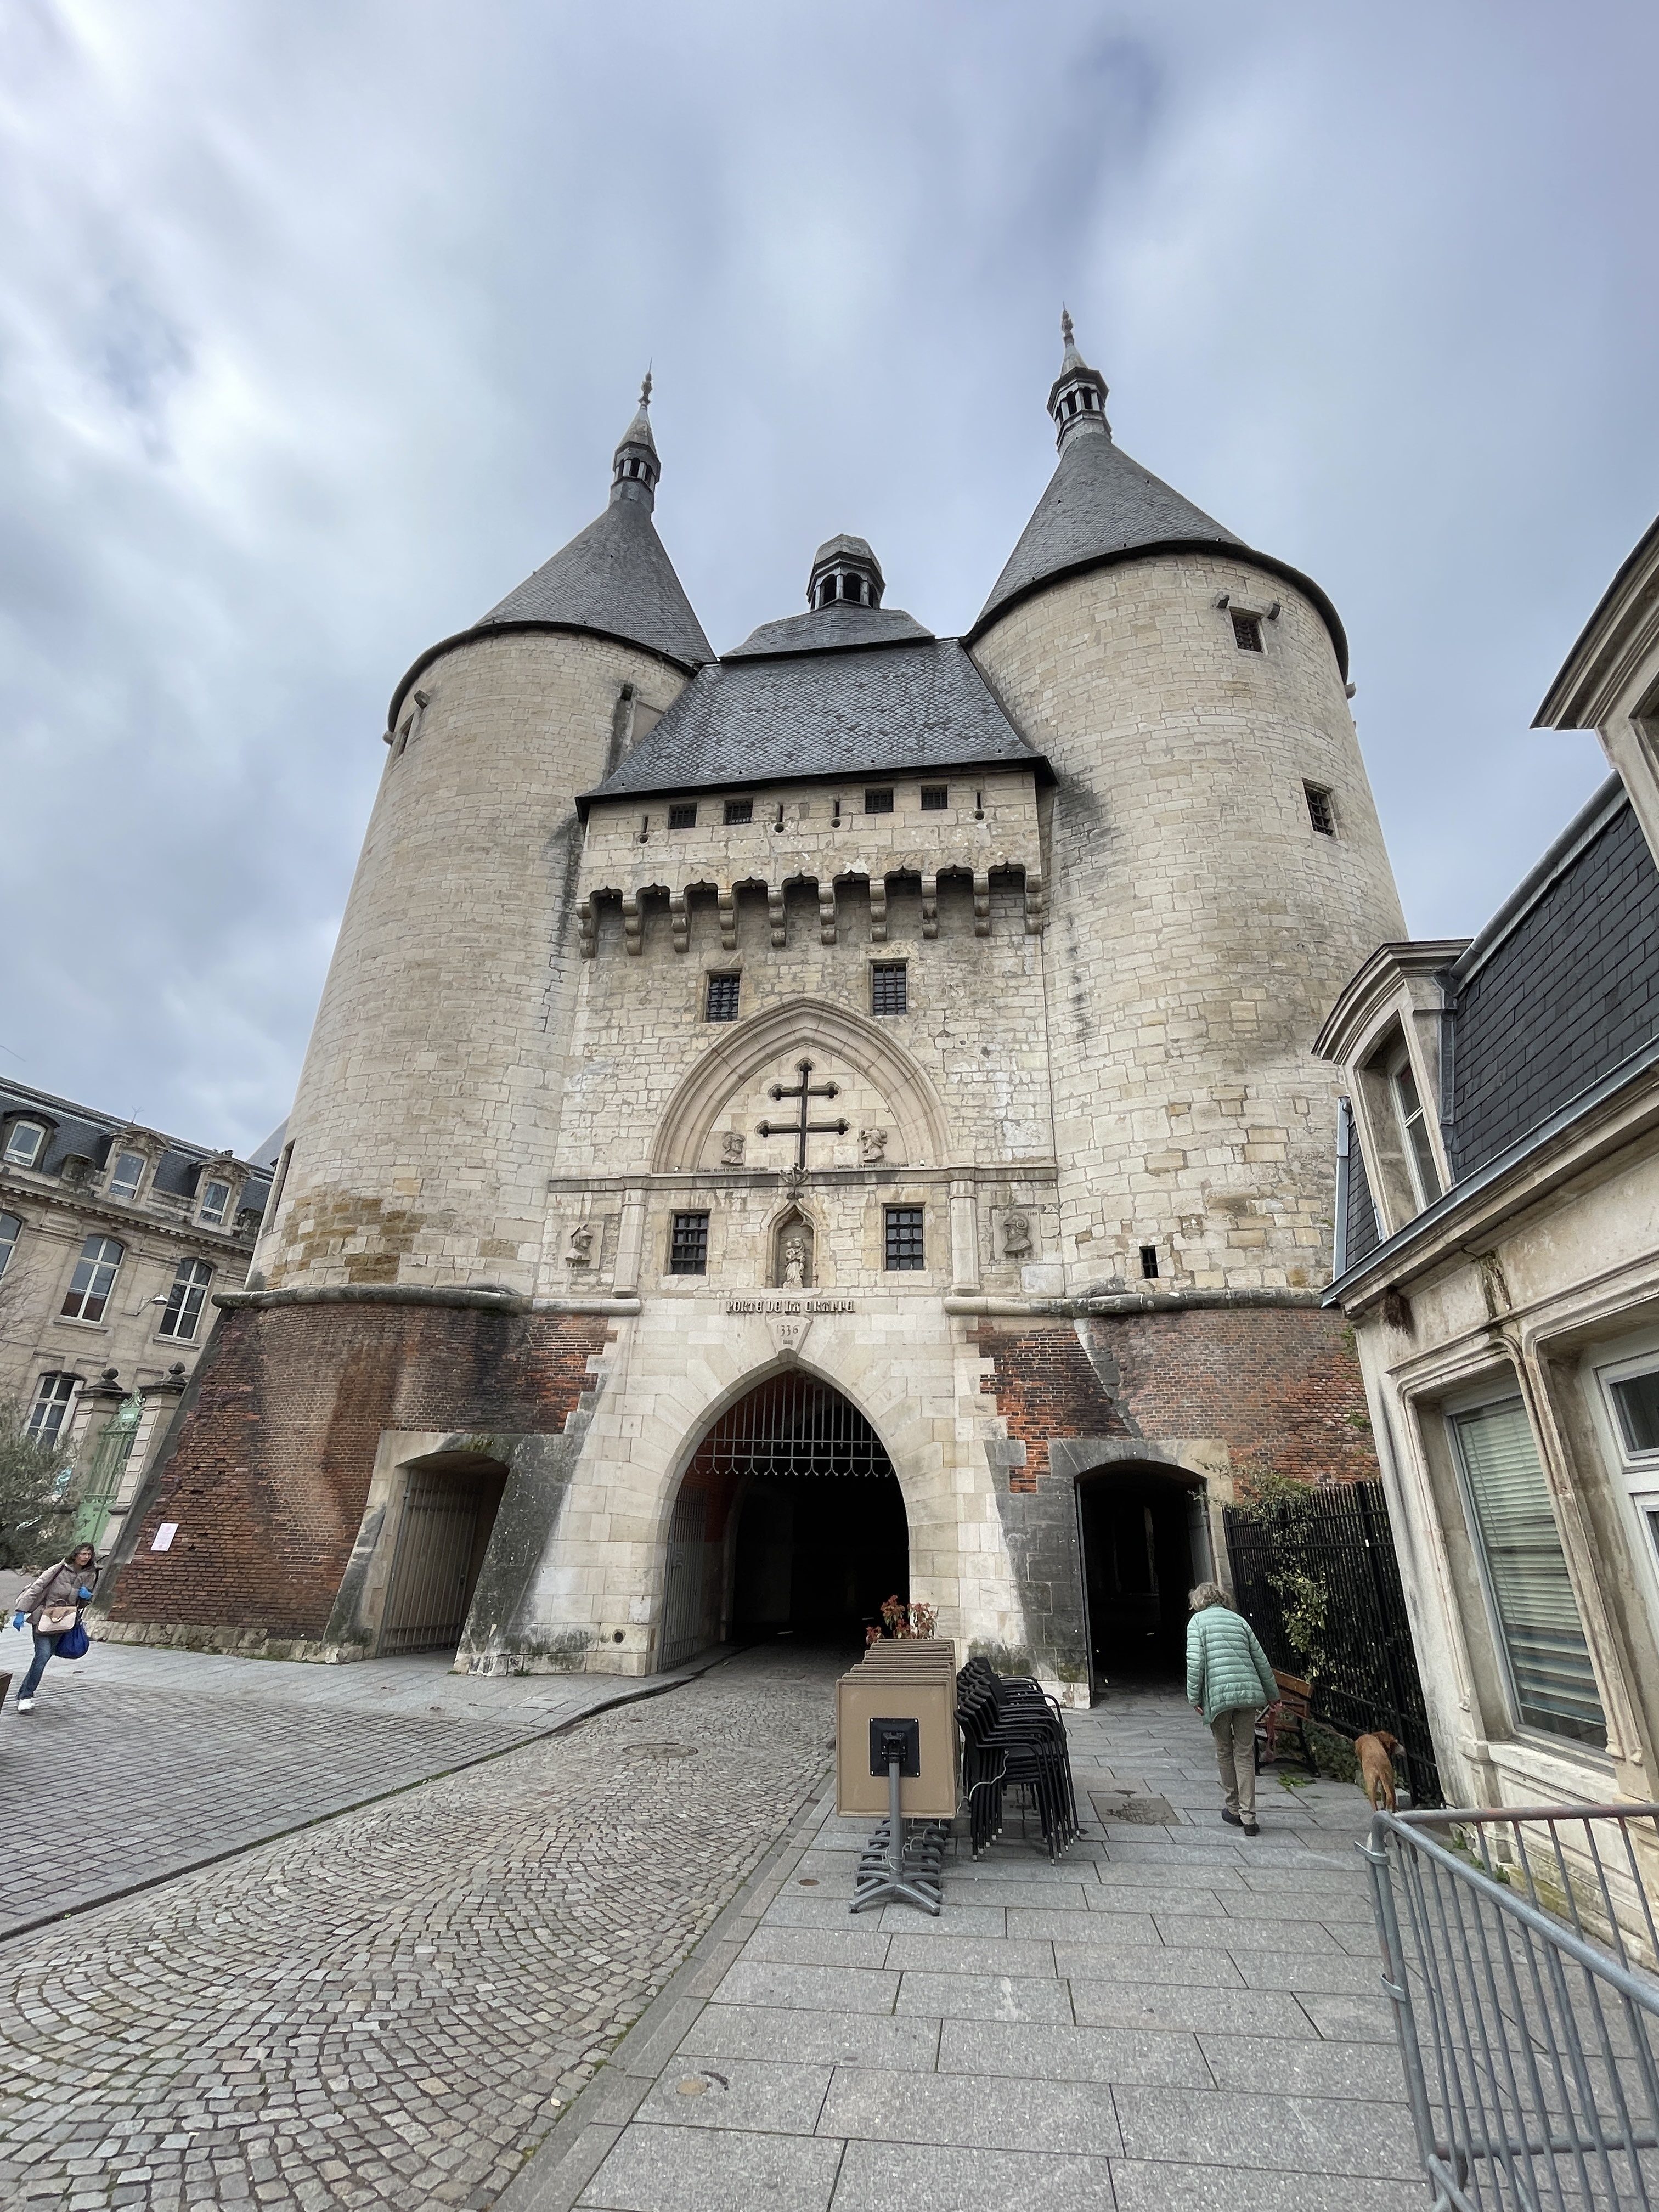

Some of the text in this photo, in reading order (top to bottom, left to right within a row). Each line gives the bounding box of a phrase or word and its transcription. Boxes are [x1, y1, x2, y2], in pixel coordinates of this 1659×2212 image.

[726, 1300, 856, 1313] PORTE DE LA CRAFFE
[776, 1324, 800, 1336] 1336
